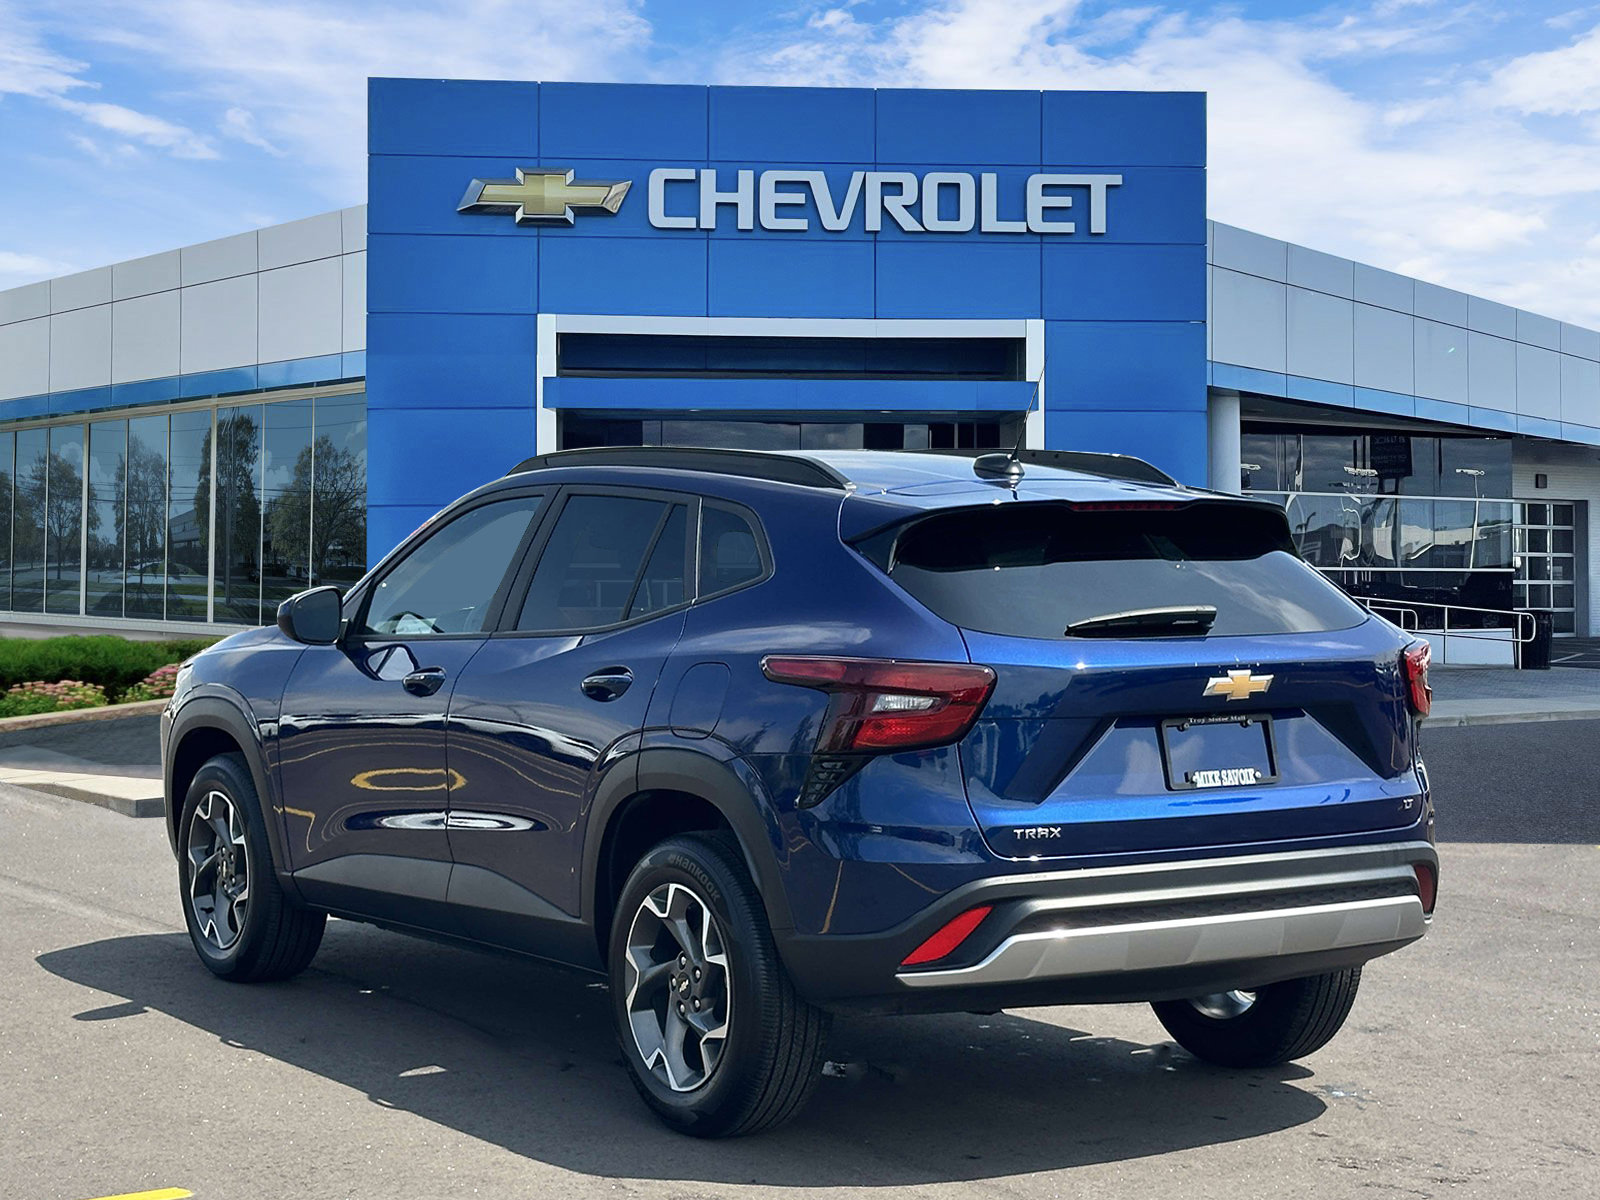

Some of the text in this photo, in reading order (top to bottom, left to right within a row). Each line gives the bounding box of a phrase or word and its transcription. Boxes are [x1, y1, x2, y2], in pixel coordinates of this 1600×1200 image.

[648, 168, 1123, 235] CHEVROLET
[1196, 770, 1221, 788] MIKE
[1013, 826, 1062, 840] TRAX
